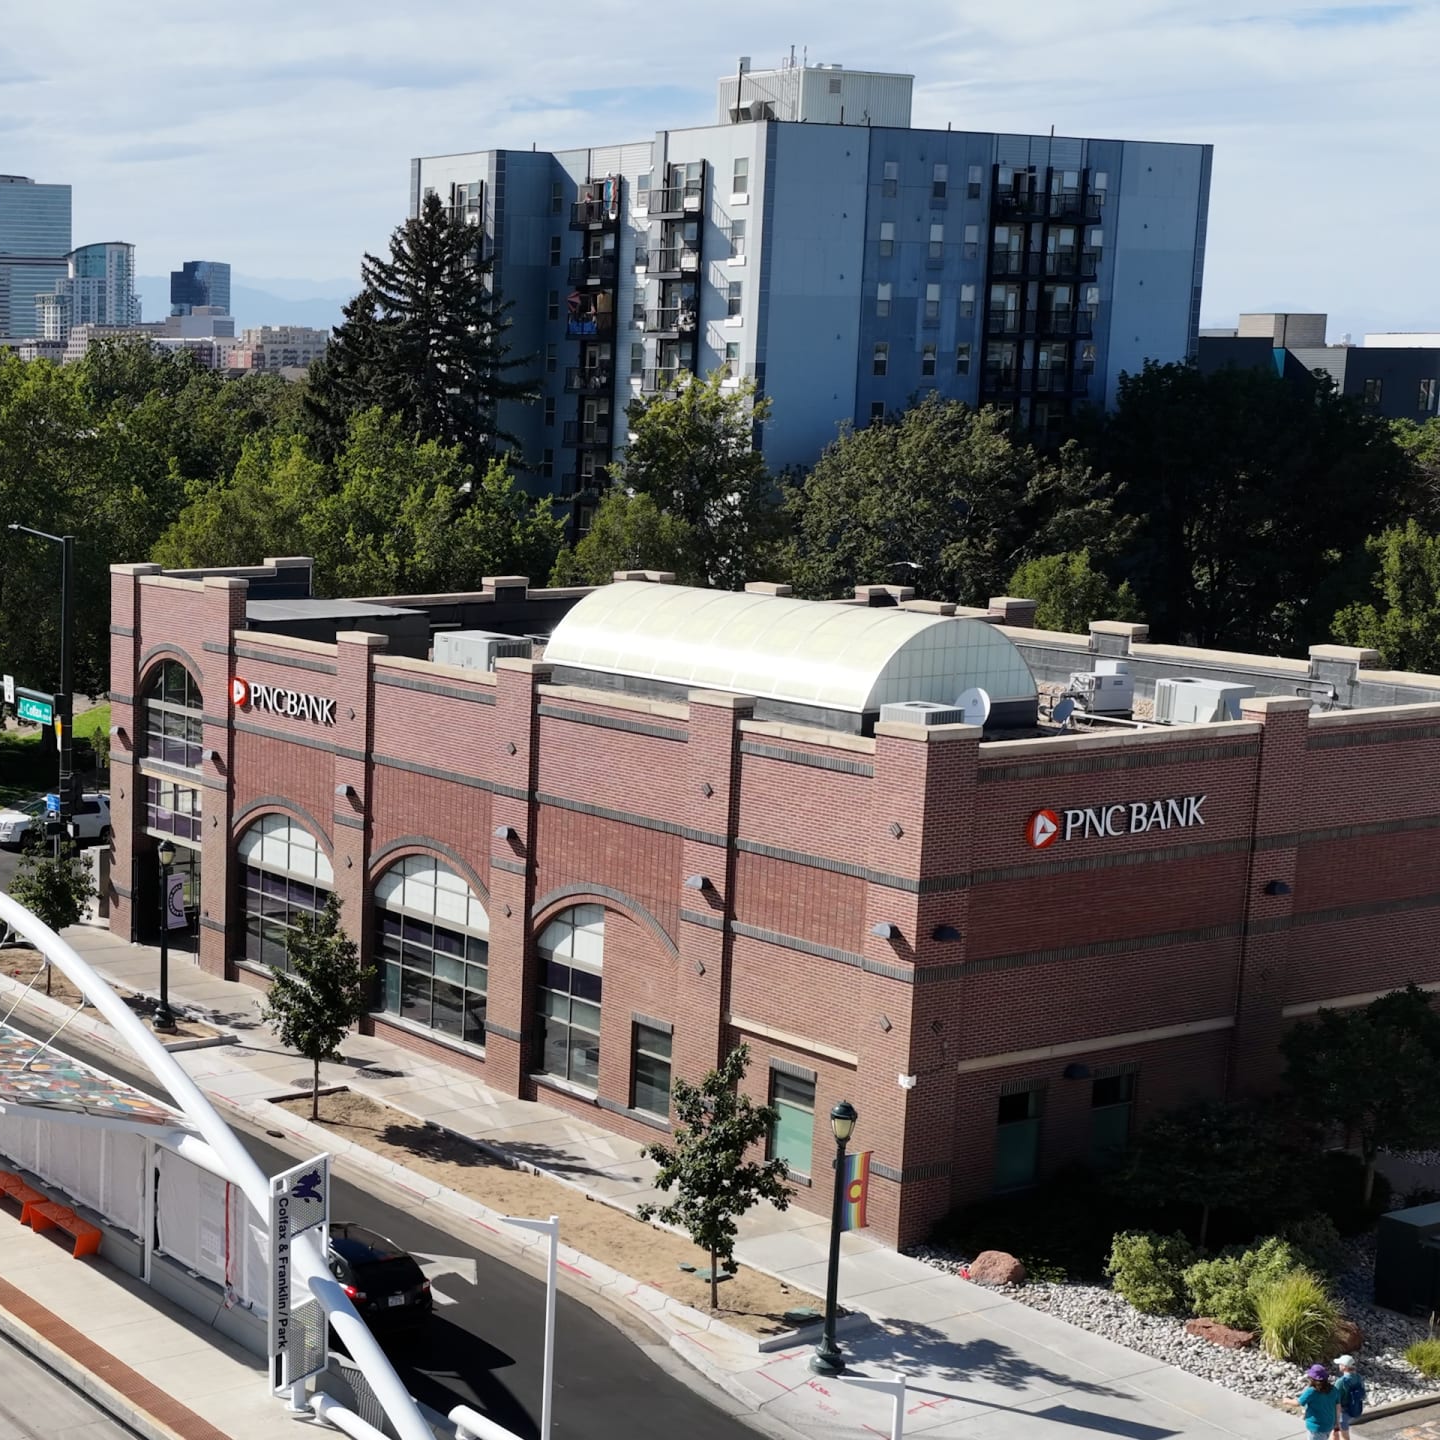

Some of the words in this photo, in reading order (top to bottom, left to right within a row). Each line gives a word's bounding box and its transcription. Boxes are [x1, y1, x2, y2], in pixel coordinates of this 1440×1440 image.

[250, 683, 285, 712] PNC
[285, 690, 335, 724] BANK
[1063, 804, 1126, 841] PNC
[1128, 795, 1207, 834] BANK
[278, 1197, 289, 1240] Colfax
[278, 1244, 289, 1252] &
[278, 1256, 289, 1309] Franklin
[277, 1319, 288, 1349] Park
